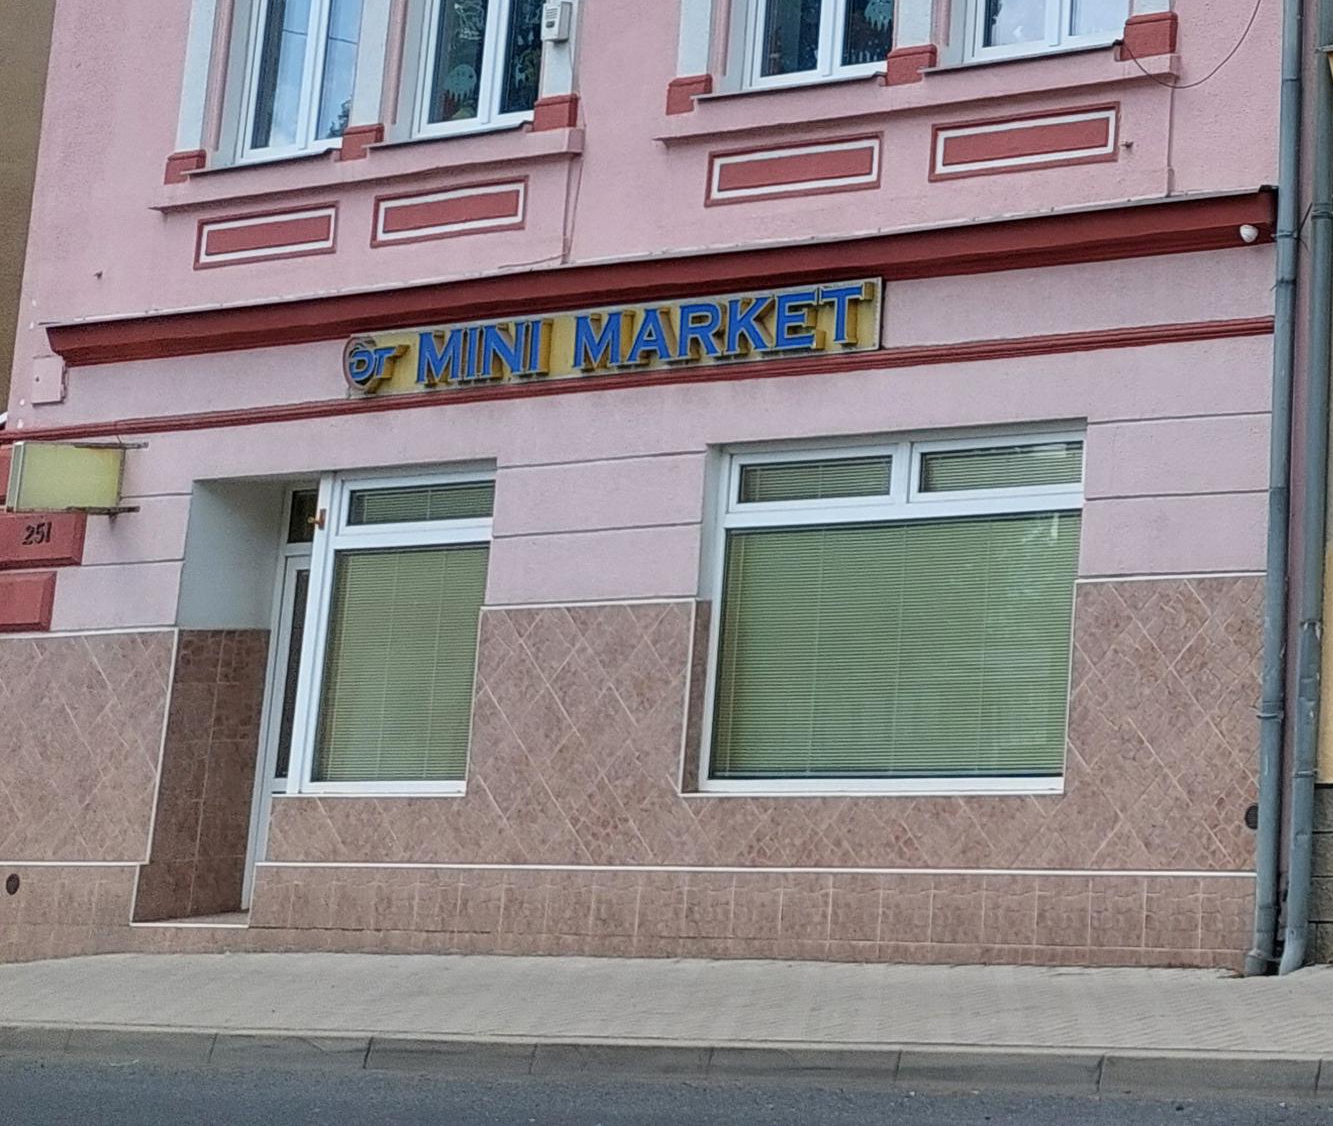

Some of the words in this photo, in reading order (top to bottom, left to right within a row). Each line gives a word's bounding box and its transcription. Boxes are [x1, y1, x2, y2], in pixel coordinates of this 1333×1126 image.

[417, 319, 544, 384] MINI
[573, 285, 865, 369] MARKET
[22, 521, 52, 545] 251
